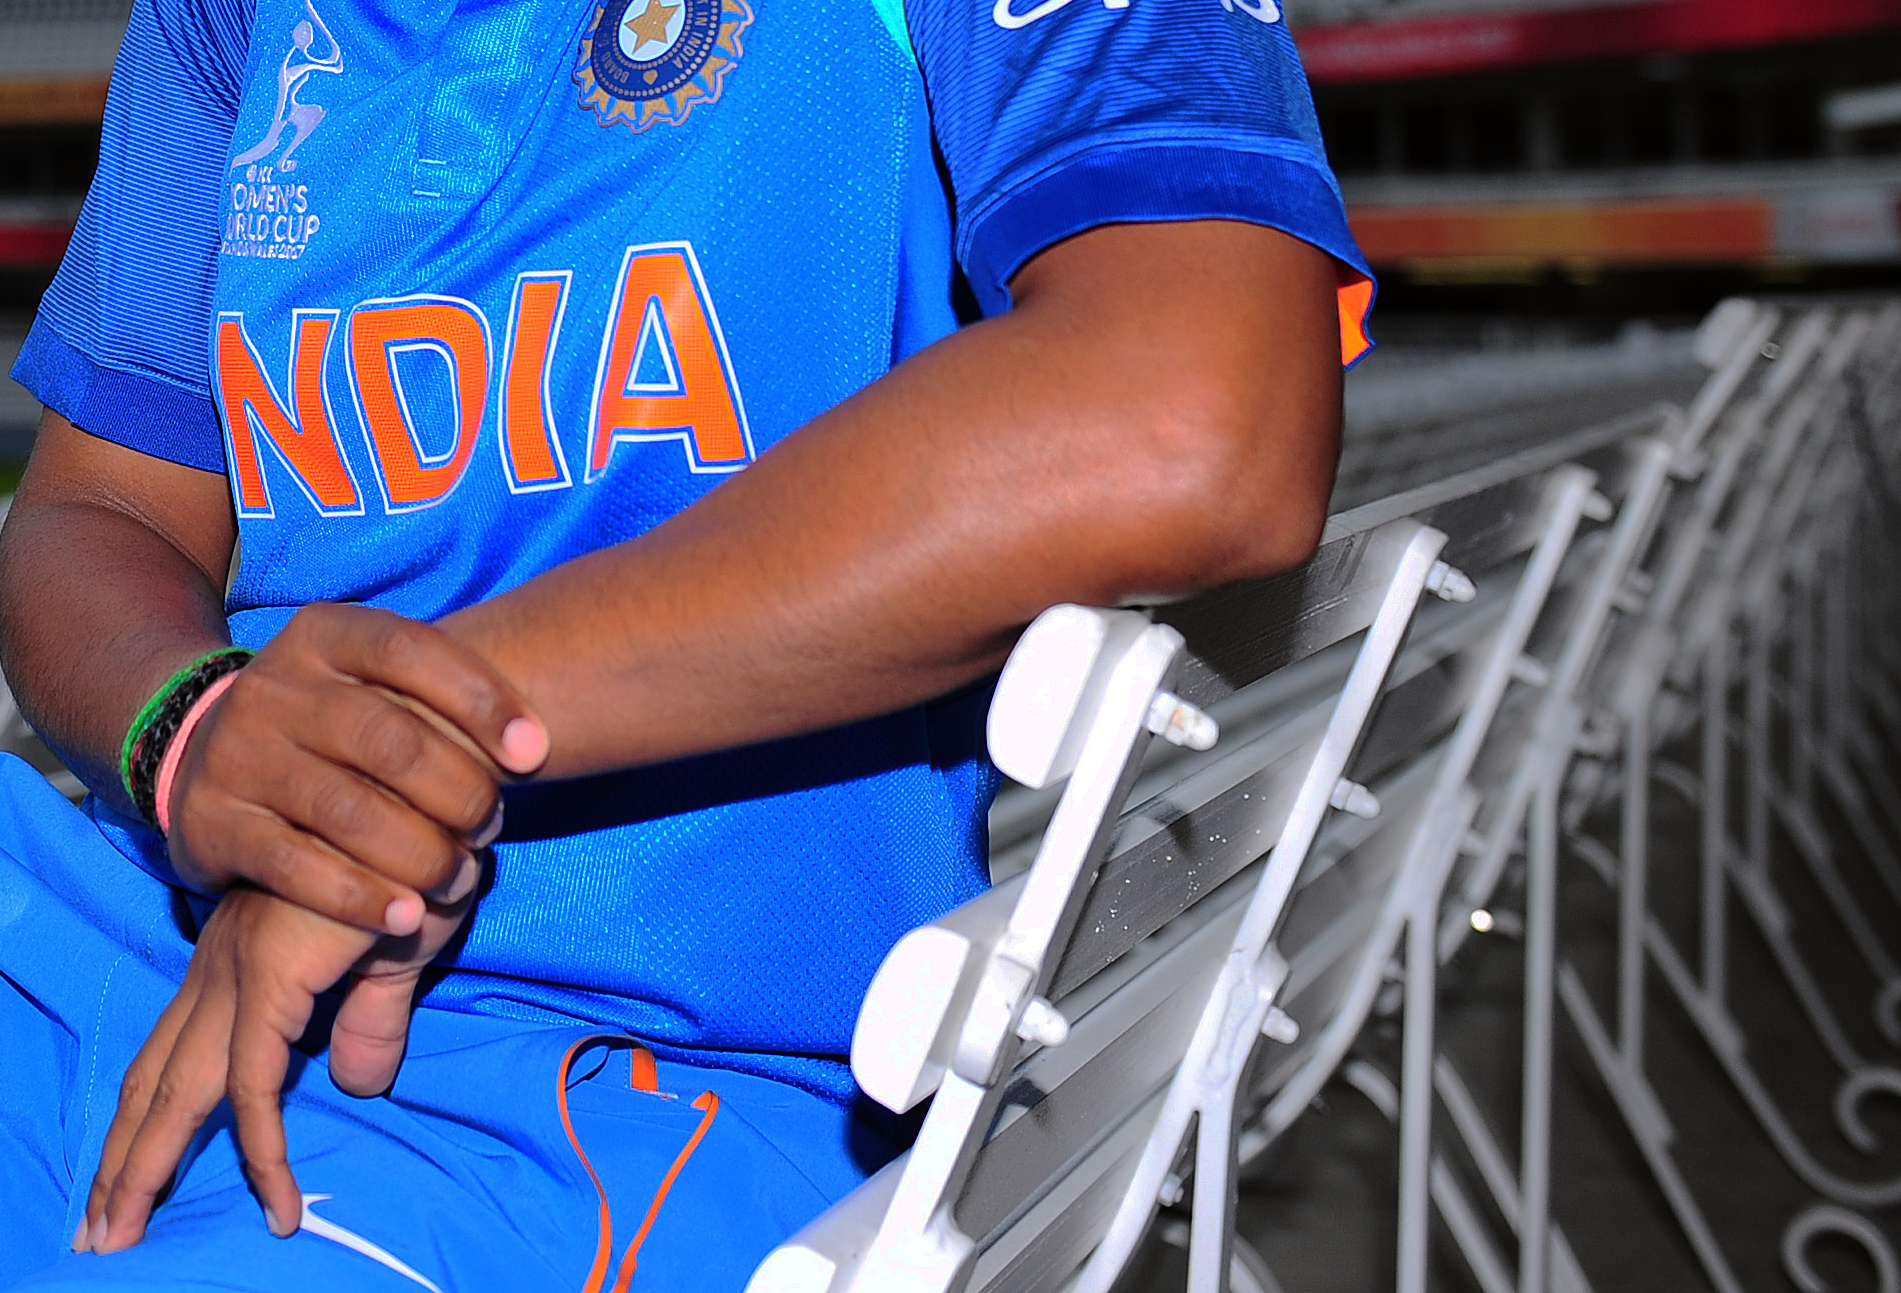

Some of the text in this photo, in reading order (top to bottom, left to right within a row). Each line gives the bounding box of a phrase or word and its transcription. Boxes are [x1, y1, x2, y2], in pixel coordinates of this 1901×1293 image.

[695, 11, 709, 27] IN
[672, 31, 704, 69] INDIA
[230, 183, 309, 214] OMEN'S
[272, 214, 321, 244] CUP
